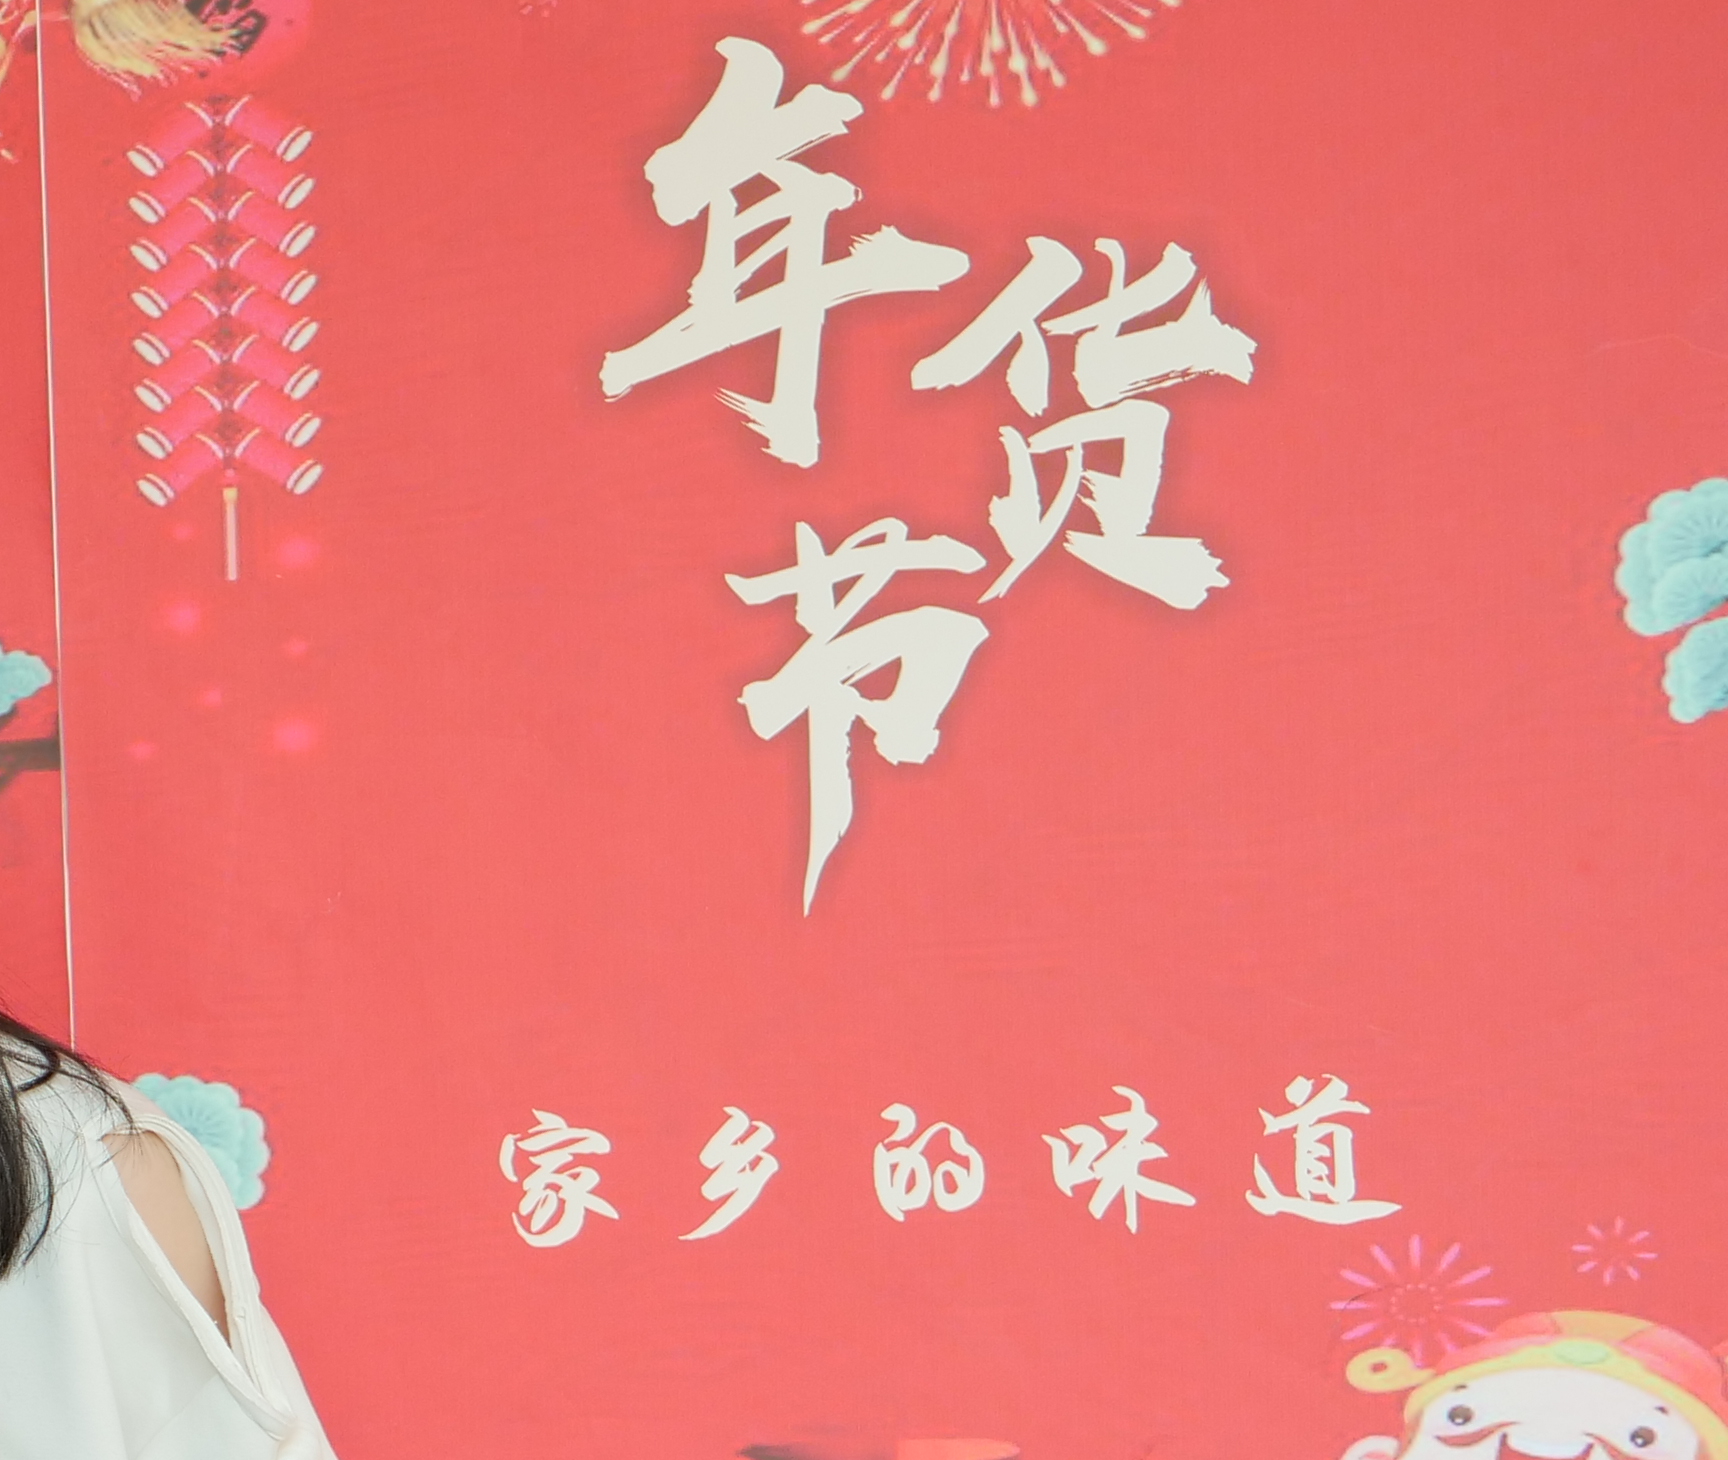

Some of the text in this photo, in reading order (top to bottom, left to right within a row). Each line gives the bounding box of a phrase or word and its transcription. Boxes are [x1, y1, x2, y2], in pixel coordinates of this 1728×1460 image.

[599, 36, 1258, 917] 年货节
[498, 1073, 1402, 1247] 家乡的味道
